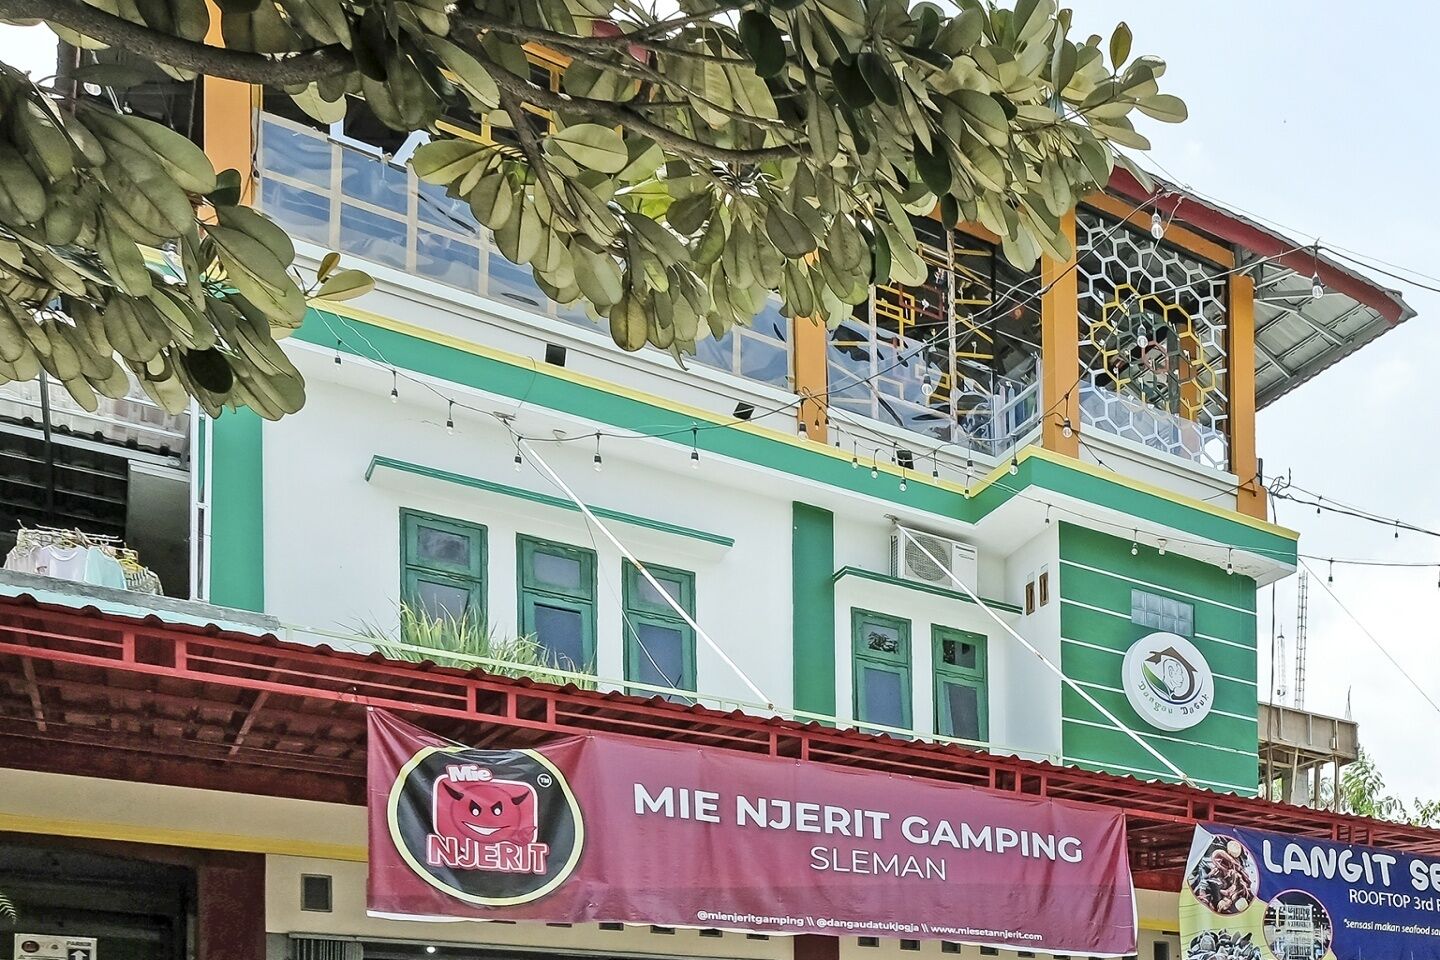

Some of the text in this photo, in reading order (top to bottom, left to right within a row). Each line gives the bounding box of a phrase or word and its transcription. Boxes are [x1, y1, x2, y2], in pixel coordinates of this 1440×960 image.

[447, 765, 493, 782] Mie
[633, 783, 1083, 864] MIE NJERIT GAMPING
[426, 833, 549, 876] NJERIT
[809, 846, 947, 882] SLEMAN
[1262, 839, 1396, 887] LANGIT
[1349, 888, 1411, 909] ROOFTOP
[1413, 896, 1434, 912] 3rd
[1374, 921, 1400, 932] makan
[1401, 924, 1431, 935] seafood
